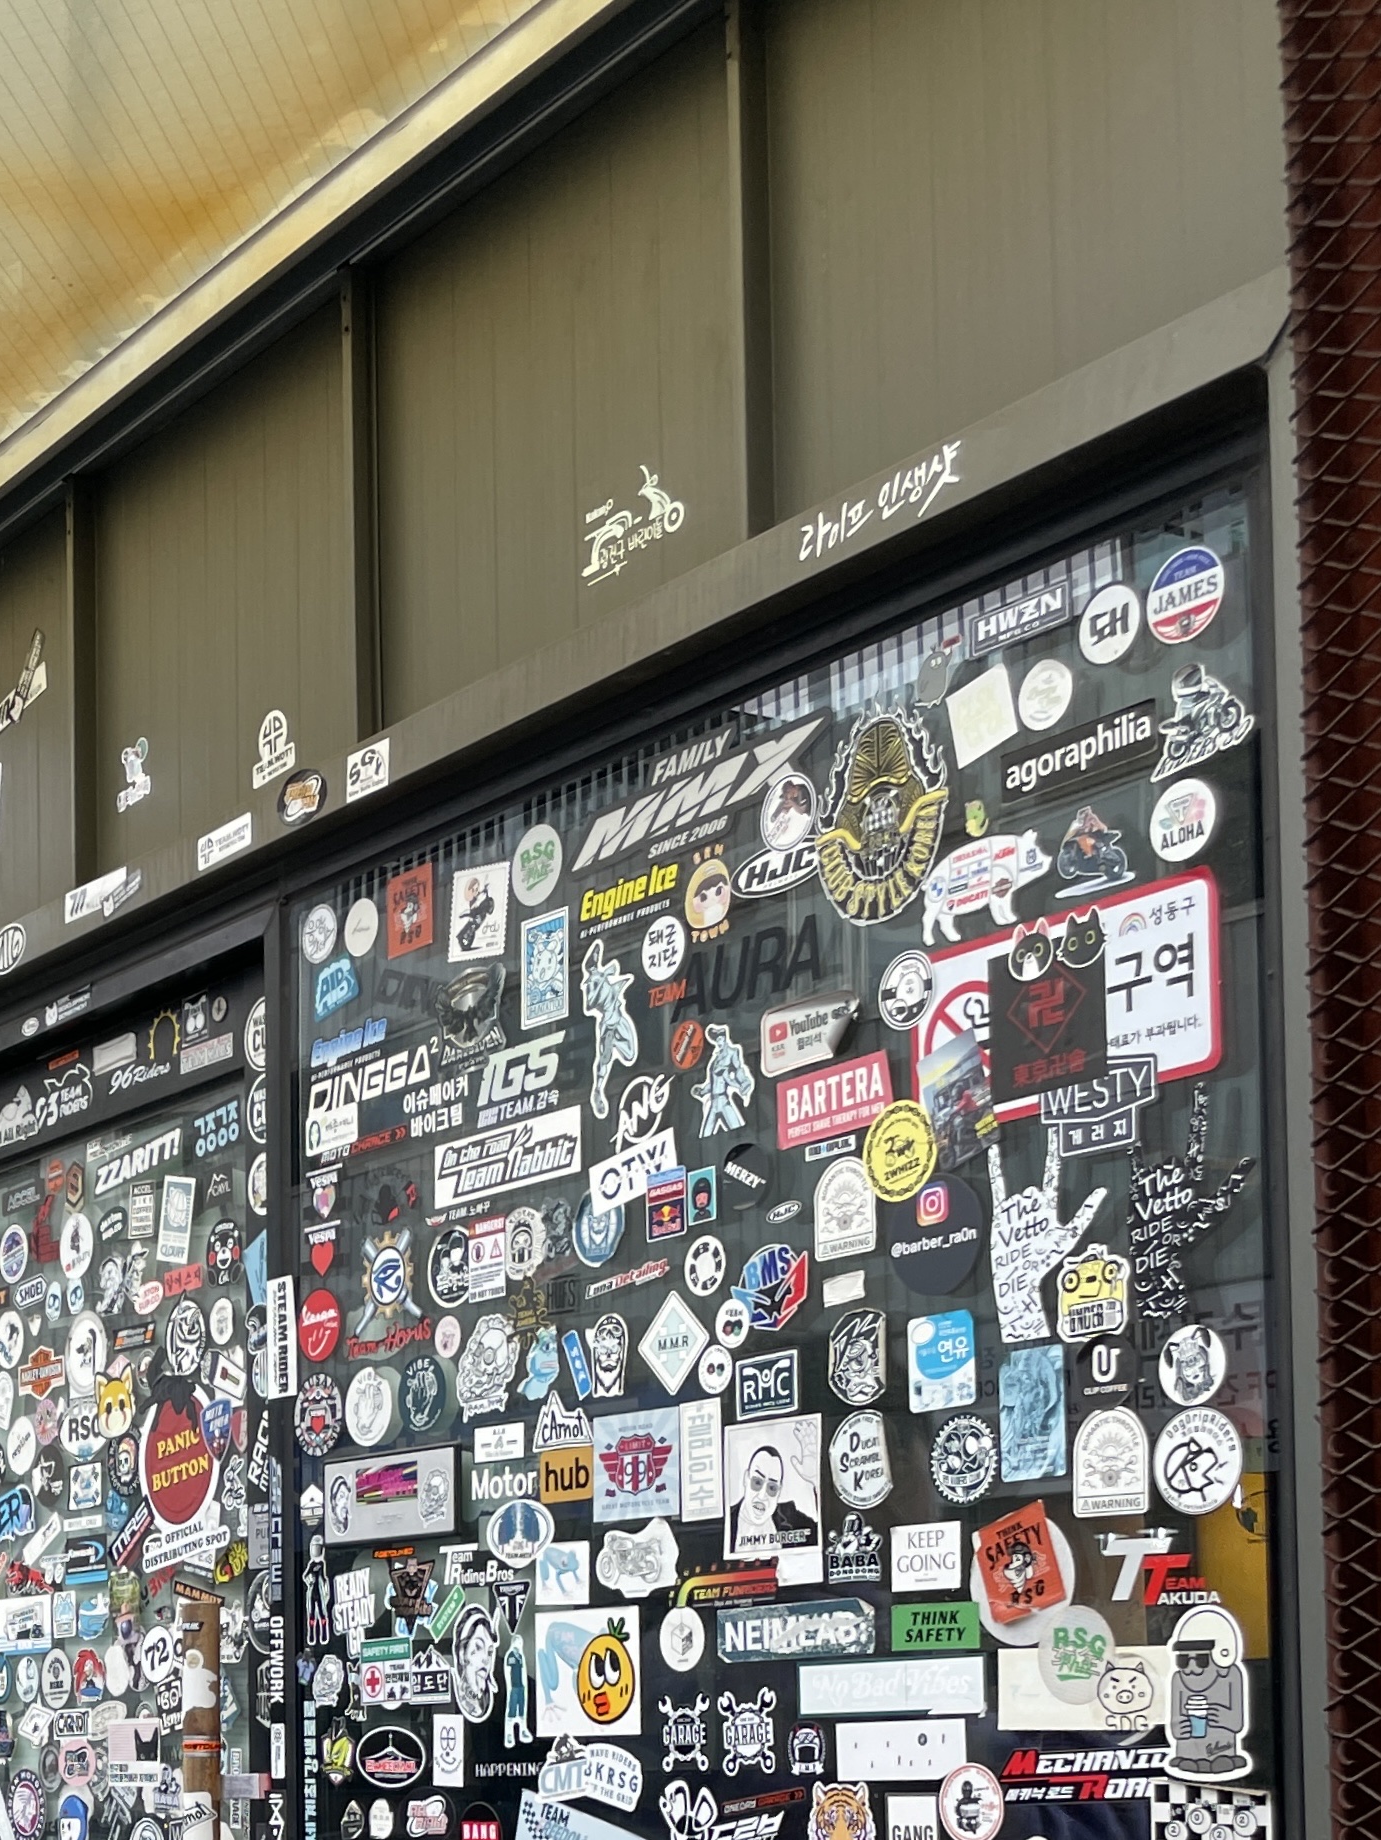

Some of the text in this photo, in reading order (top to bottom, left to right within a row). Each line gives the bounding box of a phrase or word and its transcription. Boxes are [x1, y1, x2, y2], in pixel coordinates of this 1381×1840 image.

[799, 441, 962, 561] 라이프 인생샷
[1152, 572, 1219, 615] JAMES
[976, 588, 1064, 642] HWZN
[1088, 602, 1130, 649] 돼
[651, 728, 732, 786] FAMILY
[1006, 711, 1151, 791] agoraphilia
[648, 815, 728, 859] SINCE 2006
[1159, 821, 1206, 851] ALOHA
[744, 847, 819, 892] HJC
[580, 863, 678, 922] Engine Ice
[1148, 896, 1197, 929] 성동구
[648, 924, 676, 950] 돼군
[648, 947, 678, 971] 지단
[1111, 933, 1196, 1012] 구역
[789, 1012, 828, 1036] YouTube
[403, 1075, 468, 1113] 이슈메이커
[786, 1063, 884, 1124] BARTERA
[1045, 1067, 1147, 1115] WESTY
[410, 1102, 462, 1138] 바이크팀
[321, 1144, 350, 1164] MOTO
[460, 1144, 480, 1161] the
[724, 1162, 760, 1189] MERZY
[1138, 1165, 1184, 1196] The
[1002, 1199, 1042, 1224] The
[1135, 1189, 1193, 1220] Vetto
[822, 1235, 871, 1254] WARNING
[998, 1218, 1049, 1247] Vetto
[1131, 1216, 1173, 1244] RIDE
[746, 1245, 793, 1291] BMS
[995, 1248, 1031, 1268] RIDE
[1135, 1248, 1167, 1274] DIE
[19, 1278, 43, 1301] SHOEI
[587, 1259, 668, 1298] Luna Detailing
[999, 1277, 1028, 1297] DIE
[657, 1335, 689, 1352] M.M.R
[157, 1428, 200, 1459] PANIC
[152, 1454, 209, 1492] BUTTON
[471, 1459, 589, 1499] Motor hub
[1091, 1497, 1141, 1509] WARNING
[165, 1521, 203, 1544] OFFICIAL
[739, 1534, 767, 1547] JIMMY
[906, 1529, 944, 1550] KEEP
[985, 1523, 1042, 1568] SAFETY
[145, 1531, 228, 1569] DISTRIBUTING SPOT
[830, 1554, 879, 1568] BABA
[896, 1547, 957, 1573] GOING
[175, 1583, 224, 1604] MAMMUT
[336, 1568, 370, 1602] READY
[335, 1594, 375, 1633] STEADY
[911, 1611, 960, 1627] THINK
[904, 1626, 967, 1643] SAFETY
[144, 1635, 169, 1666] 72
[663, 1724, 706, 1745] GARAGE
[726, 1724, 770, 1744] GARAGE
[541, 1761, 586, 1792] CMT
[463, 1822, 497, 1839] BANG
[541, 1804, 569, 1827] TEAM
